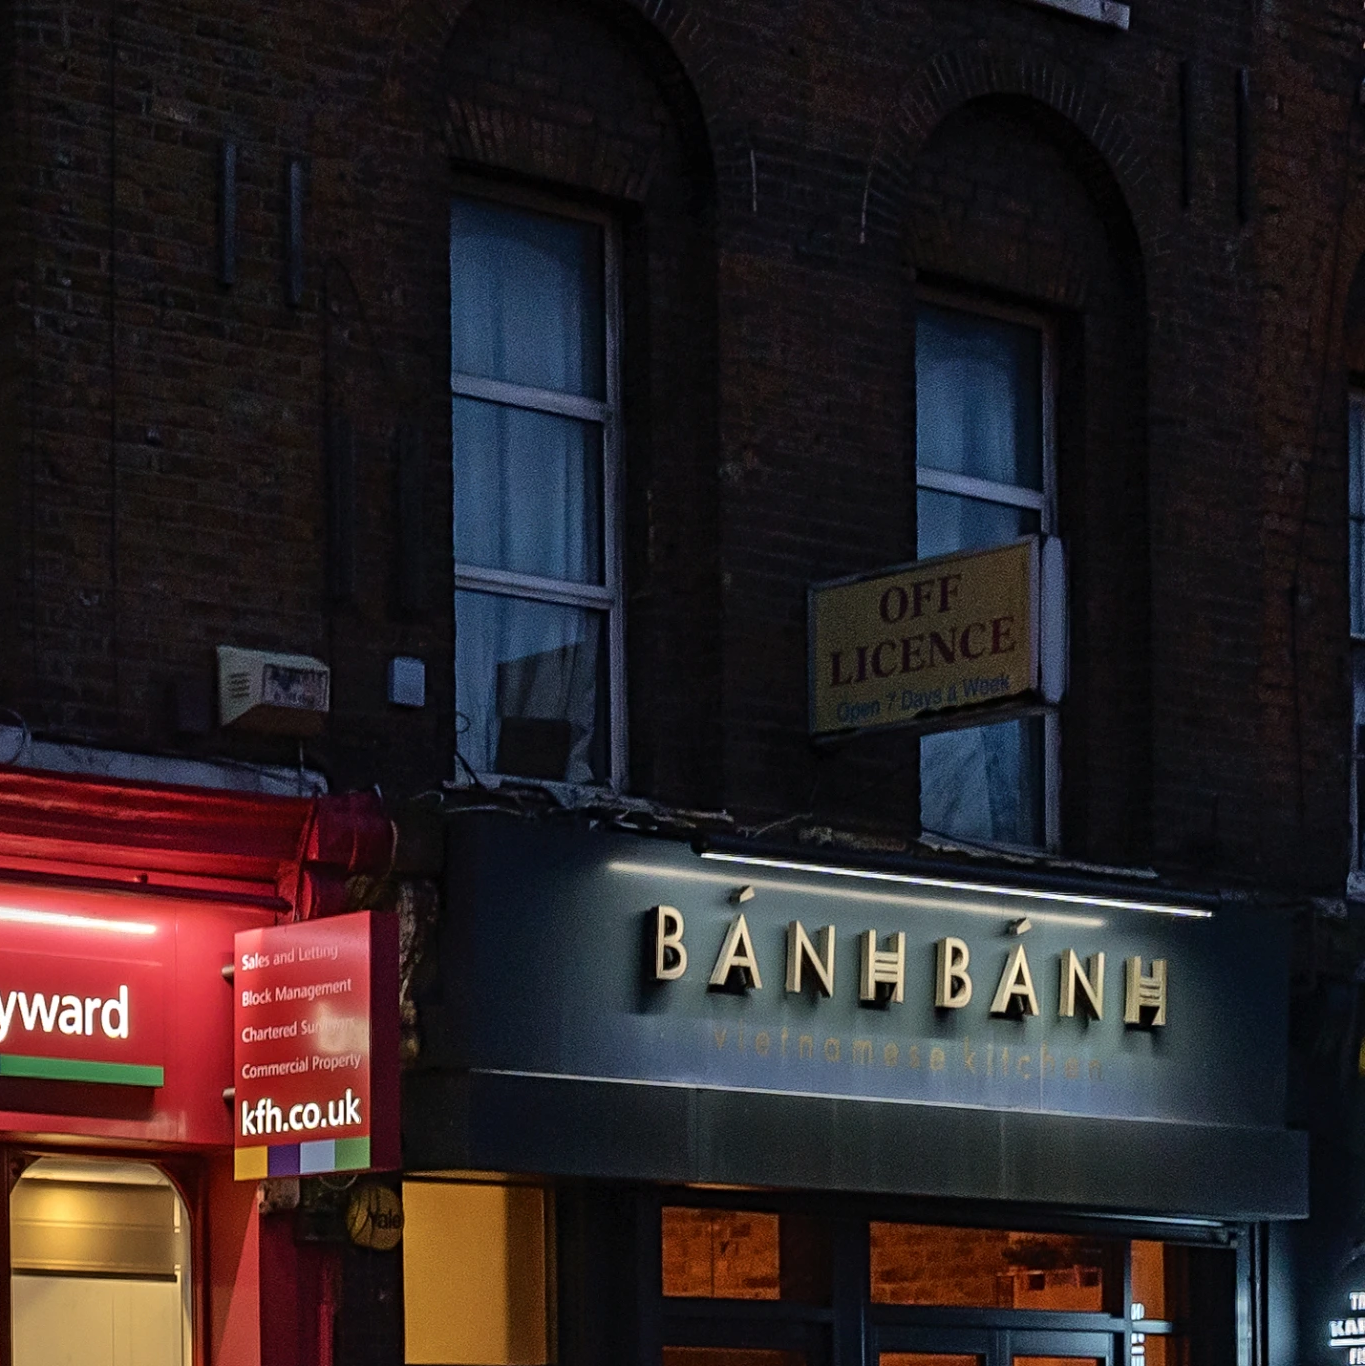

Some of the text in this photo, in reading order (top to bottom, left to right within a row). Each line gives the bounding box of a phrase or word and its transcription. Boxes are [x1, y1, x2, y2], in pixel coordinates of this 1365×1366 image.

[879, 573, 962, 624] OFF
[830, 616, 1015, 686] LICENCE
[241, 951, 270, 971] Sales
[273, 948, 295, 966] and
[242, 978, 352, 1007] Block Management
[241, 1021, 298, 1043] Chartered
[713, 1019, 1102, 1081] vietnamese kitchen
[241, 1053, 361, 1080] Commercial Property
[241, 1087, 362, 1136] kfh.co.uk
